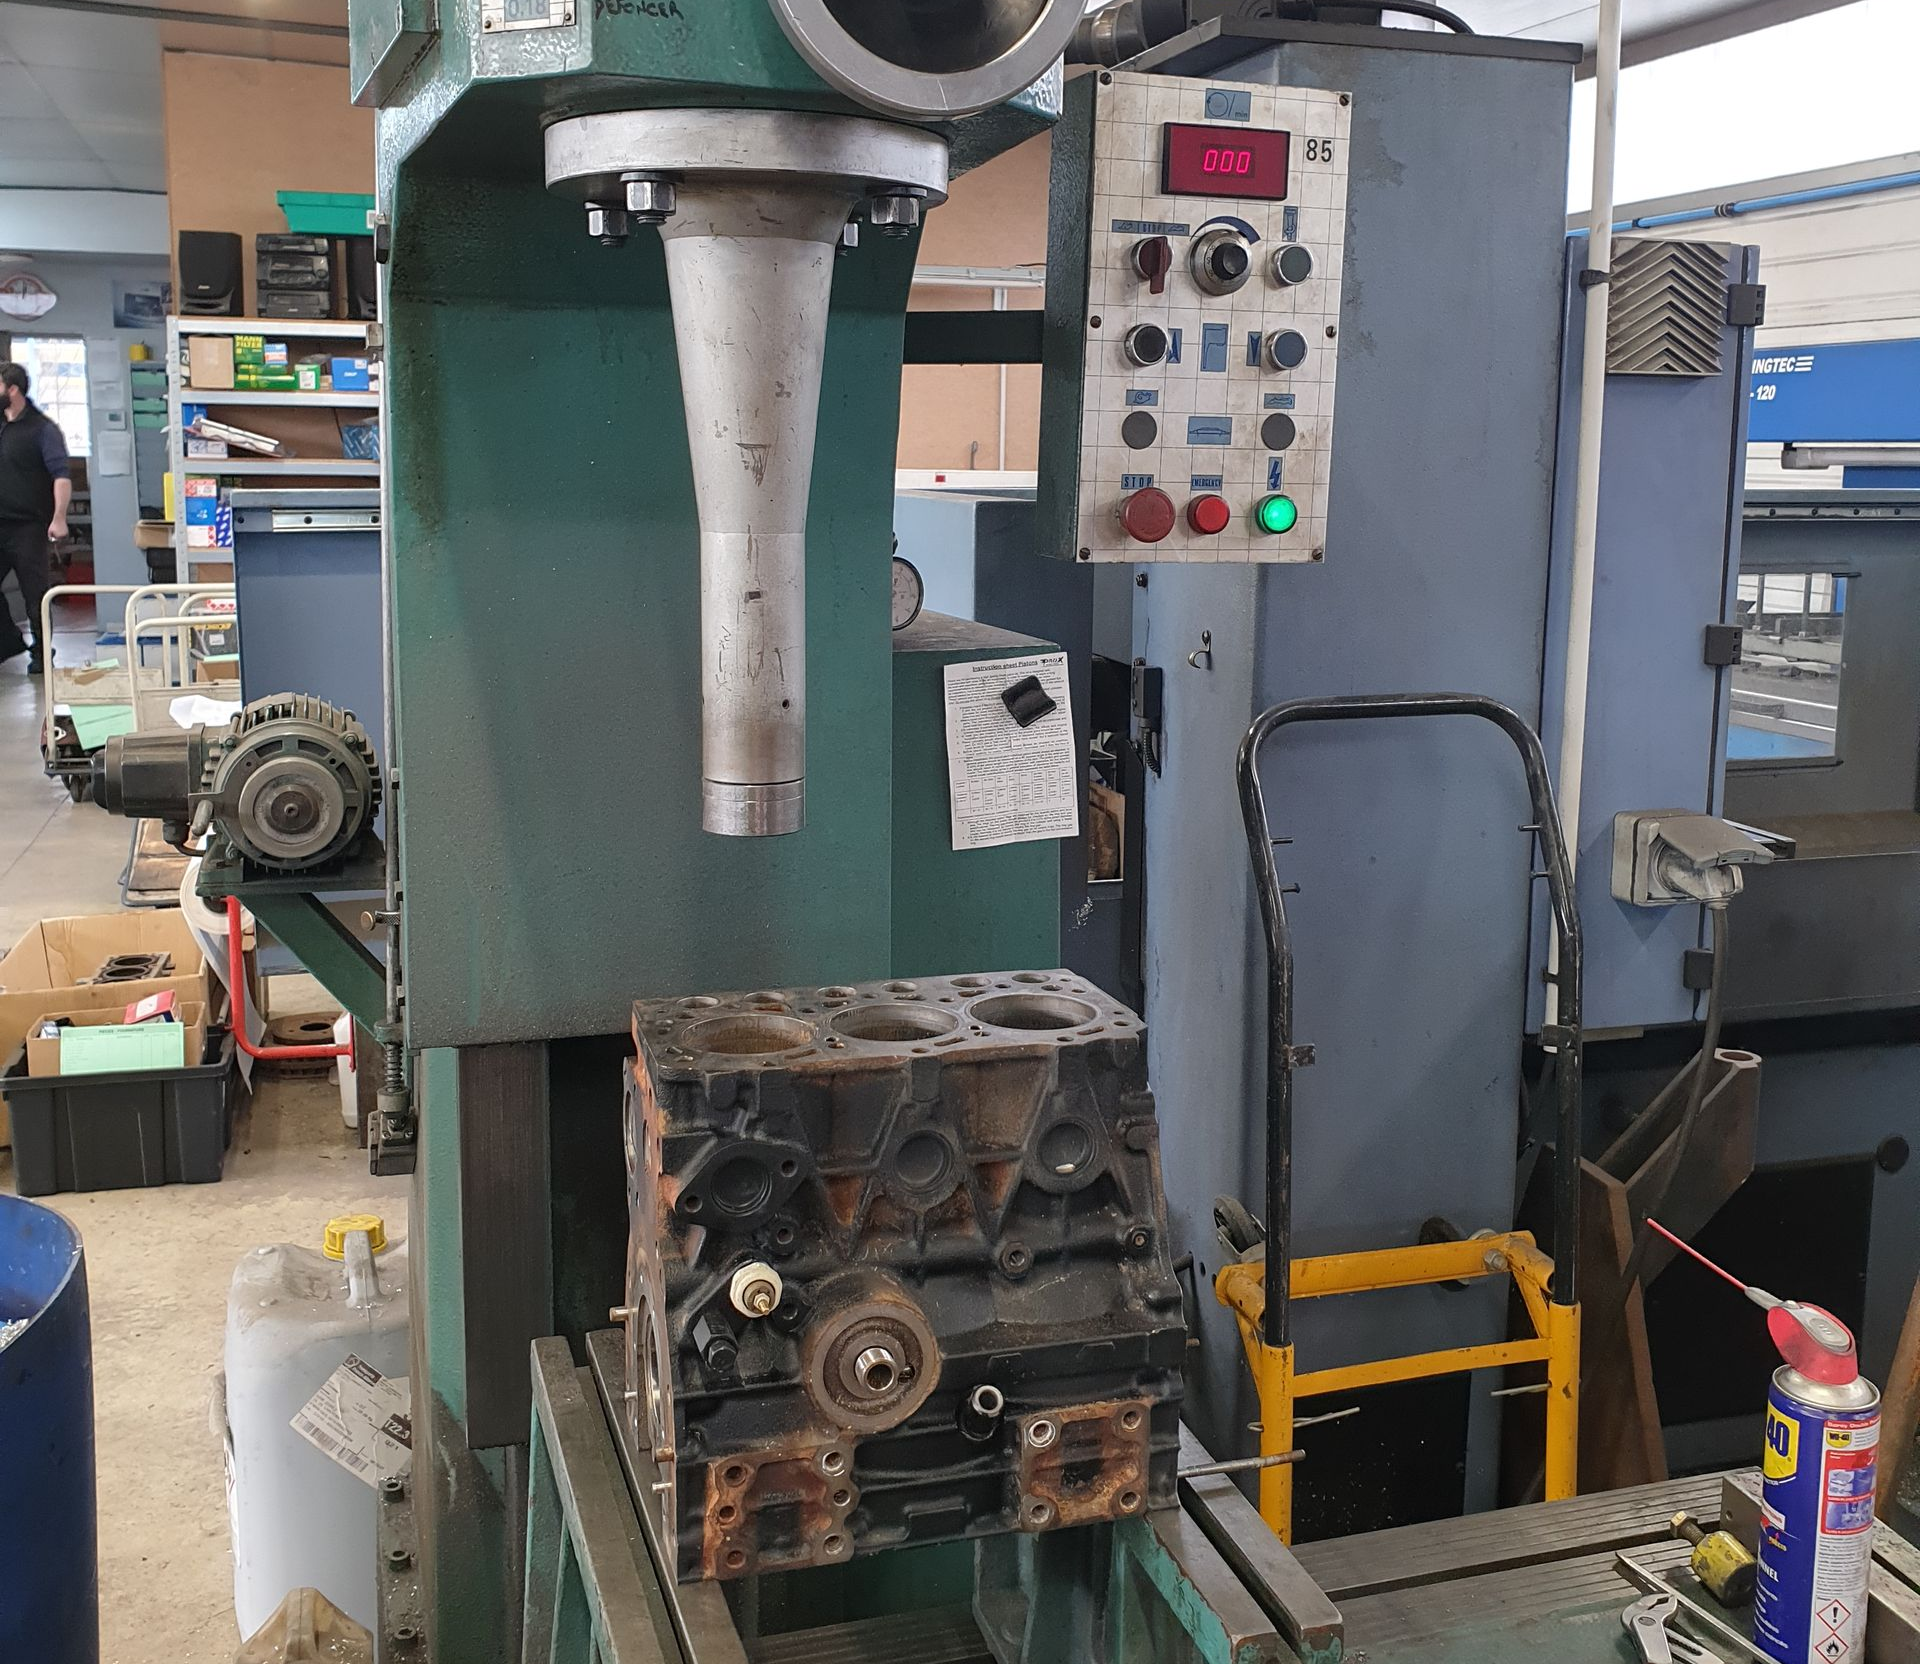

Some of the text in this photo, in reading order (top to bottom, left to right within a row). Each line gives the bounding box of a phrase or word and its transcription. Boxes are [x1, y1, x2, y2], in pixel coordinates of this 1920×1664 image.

[1306, 138, 1332, 163] 85
[1203, 149, 1251, 173] 000
[1756, 384, 1777, 400] 120
[1124, 477, 1152, 488] STOP
[1191, 479, 1221, 487] EMERGENCY
[972, 664, 1002, 672] Instruction
